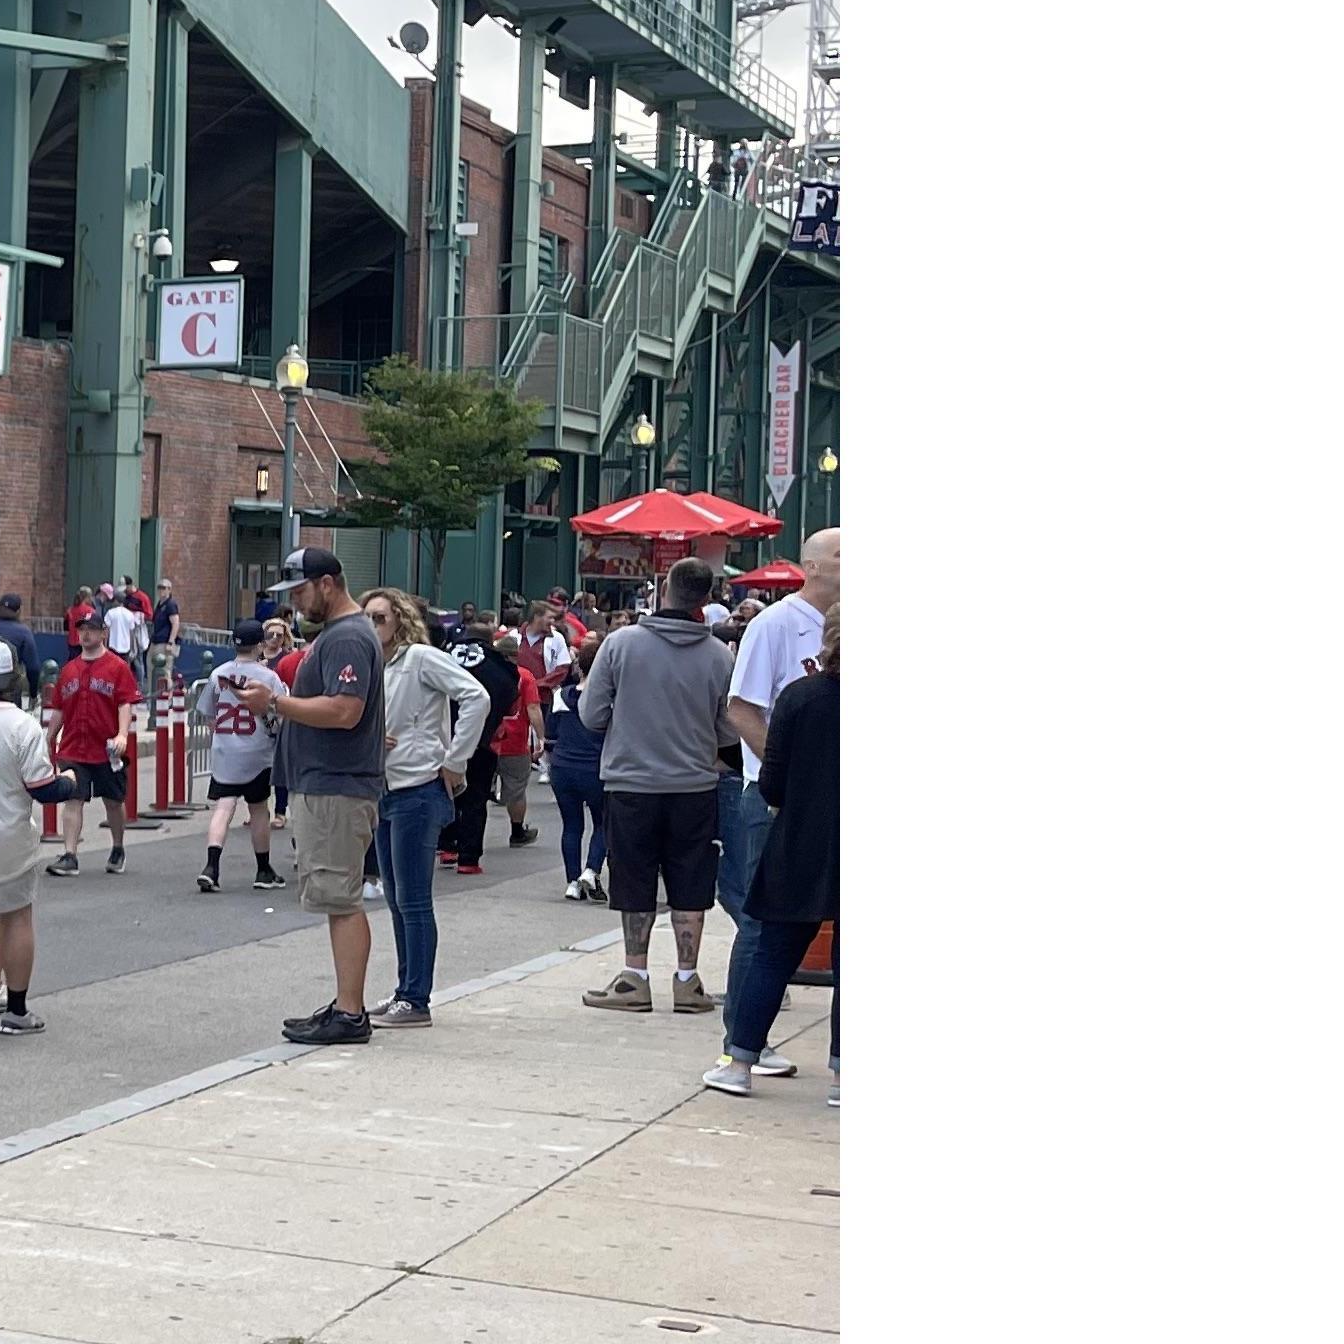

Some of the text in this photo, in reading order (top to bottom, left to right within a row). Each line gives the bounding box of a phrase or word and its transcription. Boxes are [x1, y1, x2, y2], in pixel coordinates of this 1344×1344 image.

[167, 288, 235, 306] GATE
[181, 312, 217, 357] C
[773, 364, 791, 476] BLEACHER BAR
[214, 702, 257, 736] 28
